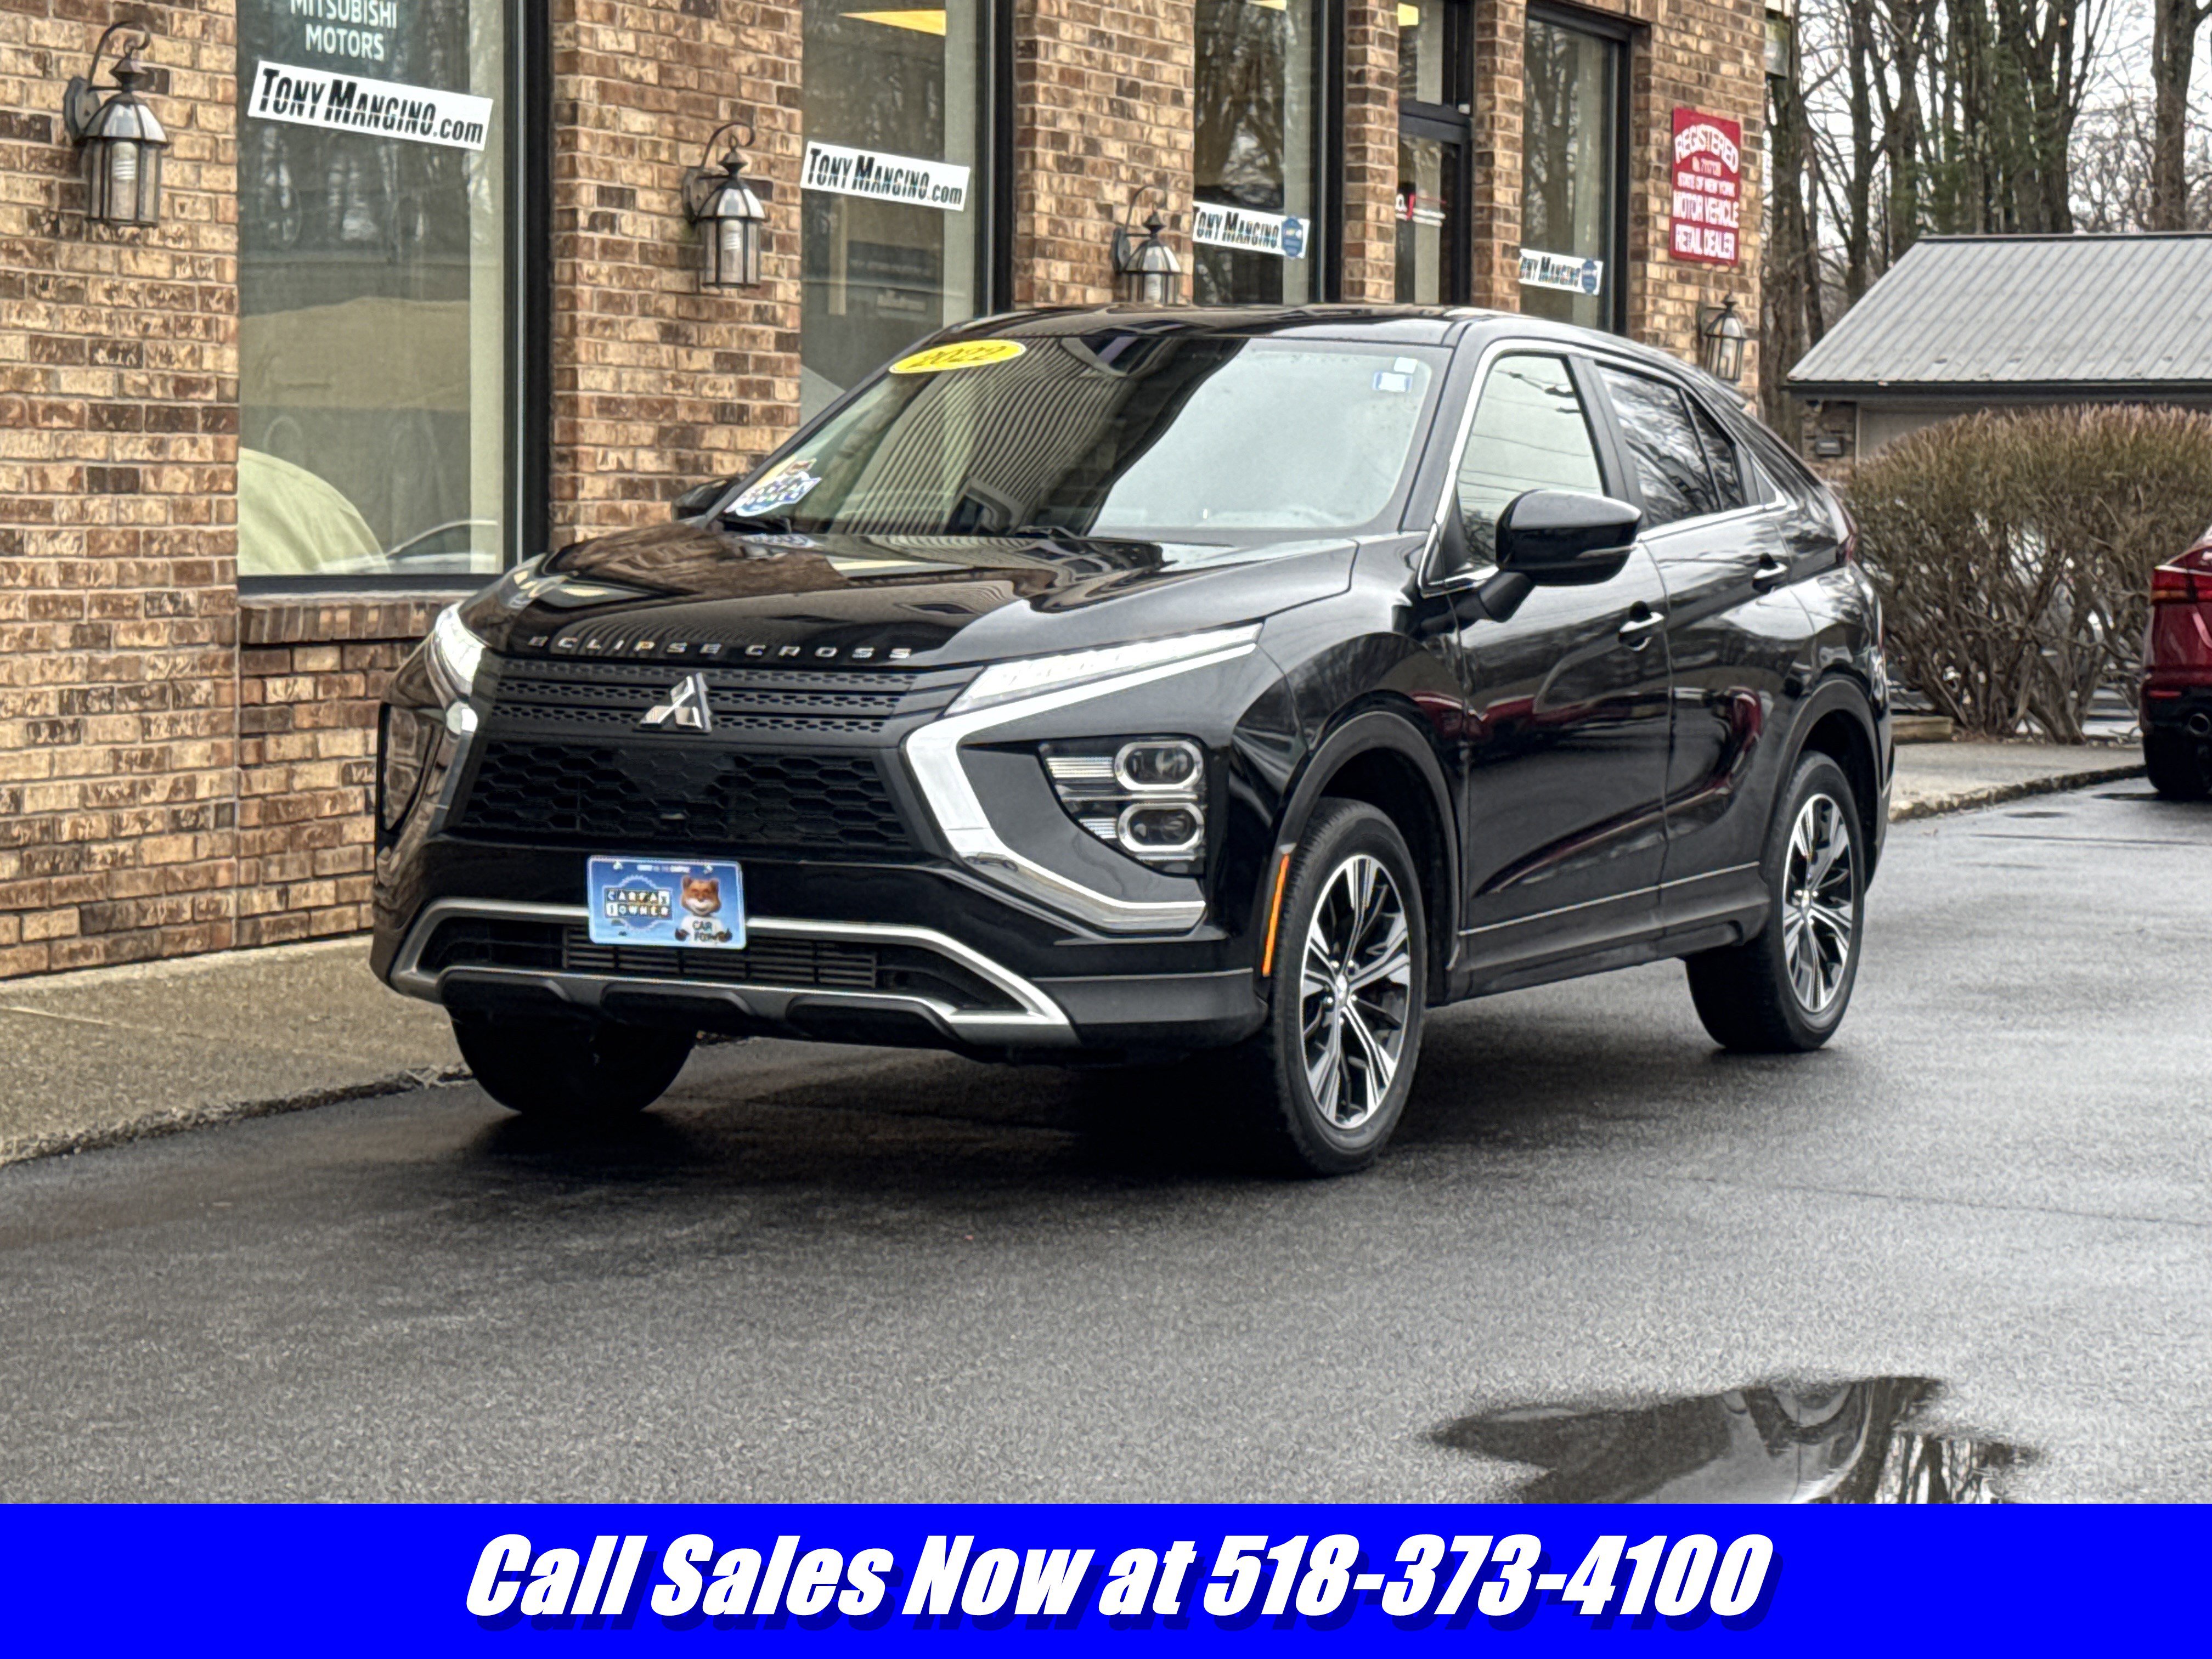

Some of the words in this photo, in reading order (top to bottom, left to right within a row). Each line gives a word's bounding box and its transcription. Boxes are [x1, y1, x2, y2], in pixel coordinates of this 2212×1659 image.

[290, 0, 397, 29] MITSUBISHI
[306, 24, 385, 61] MOTORS
[1674, 123, 1739, 173] REGISTERED
[1673, 189, 1703, 222] MOTOR
[1705, 195, 1739, 229] VEHICLE
[1675, 223, 1702, 255] RETAIL
[1703, 228, 1735, 260] DEALER
[906, 346, 1007, 369] 2022
[528, 635, 723, 655] ECLIPSE
[744, 644, 912, 659] CROSS
[607, 890, 669, 905] CARFAX
[692, 920, 712, 931] CAR
